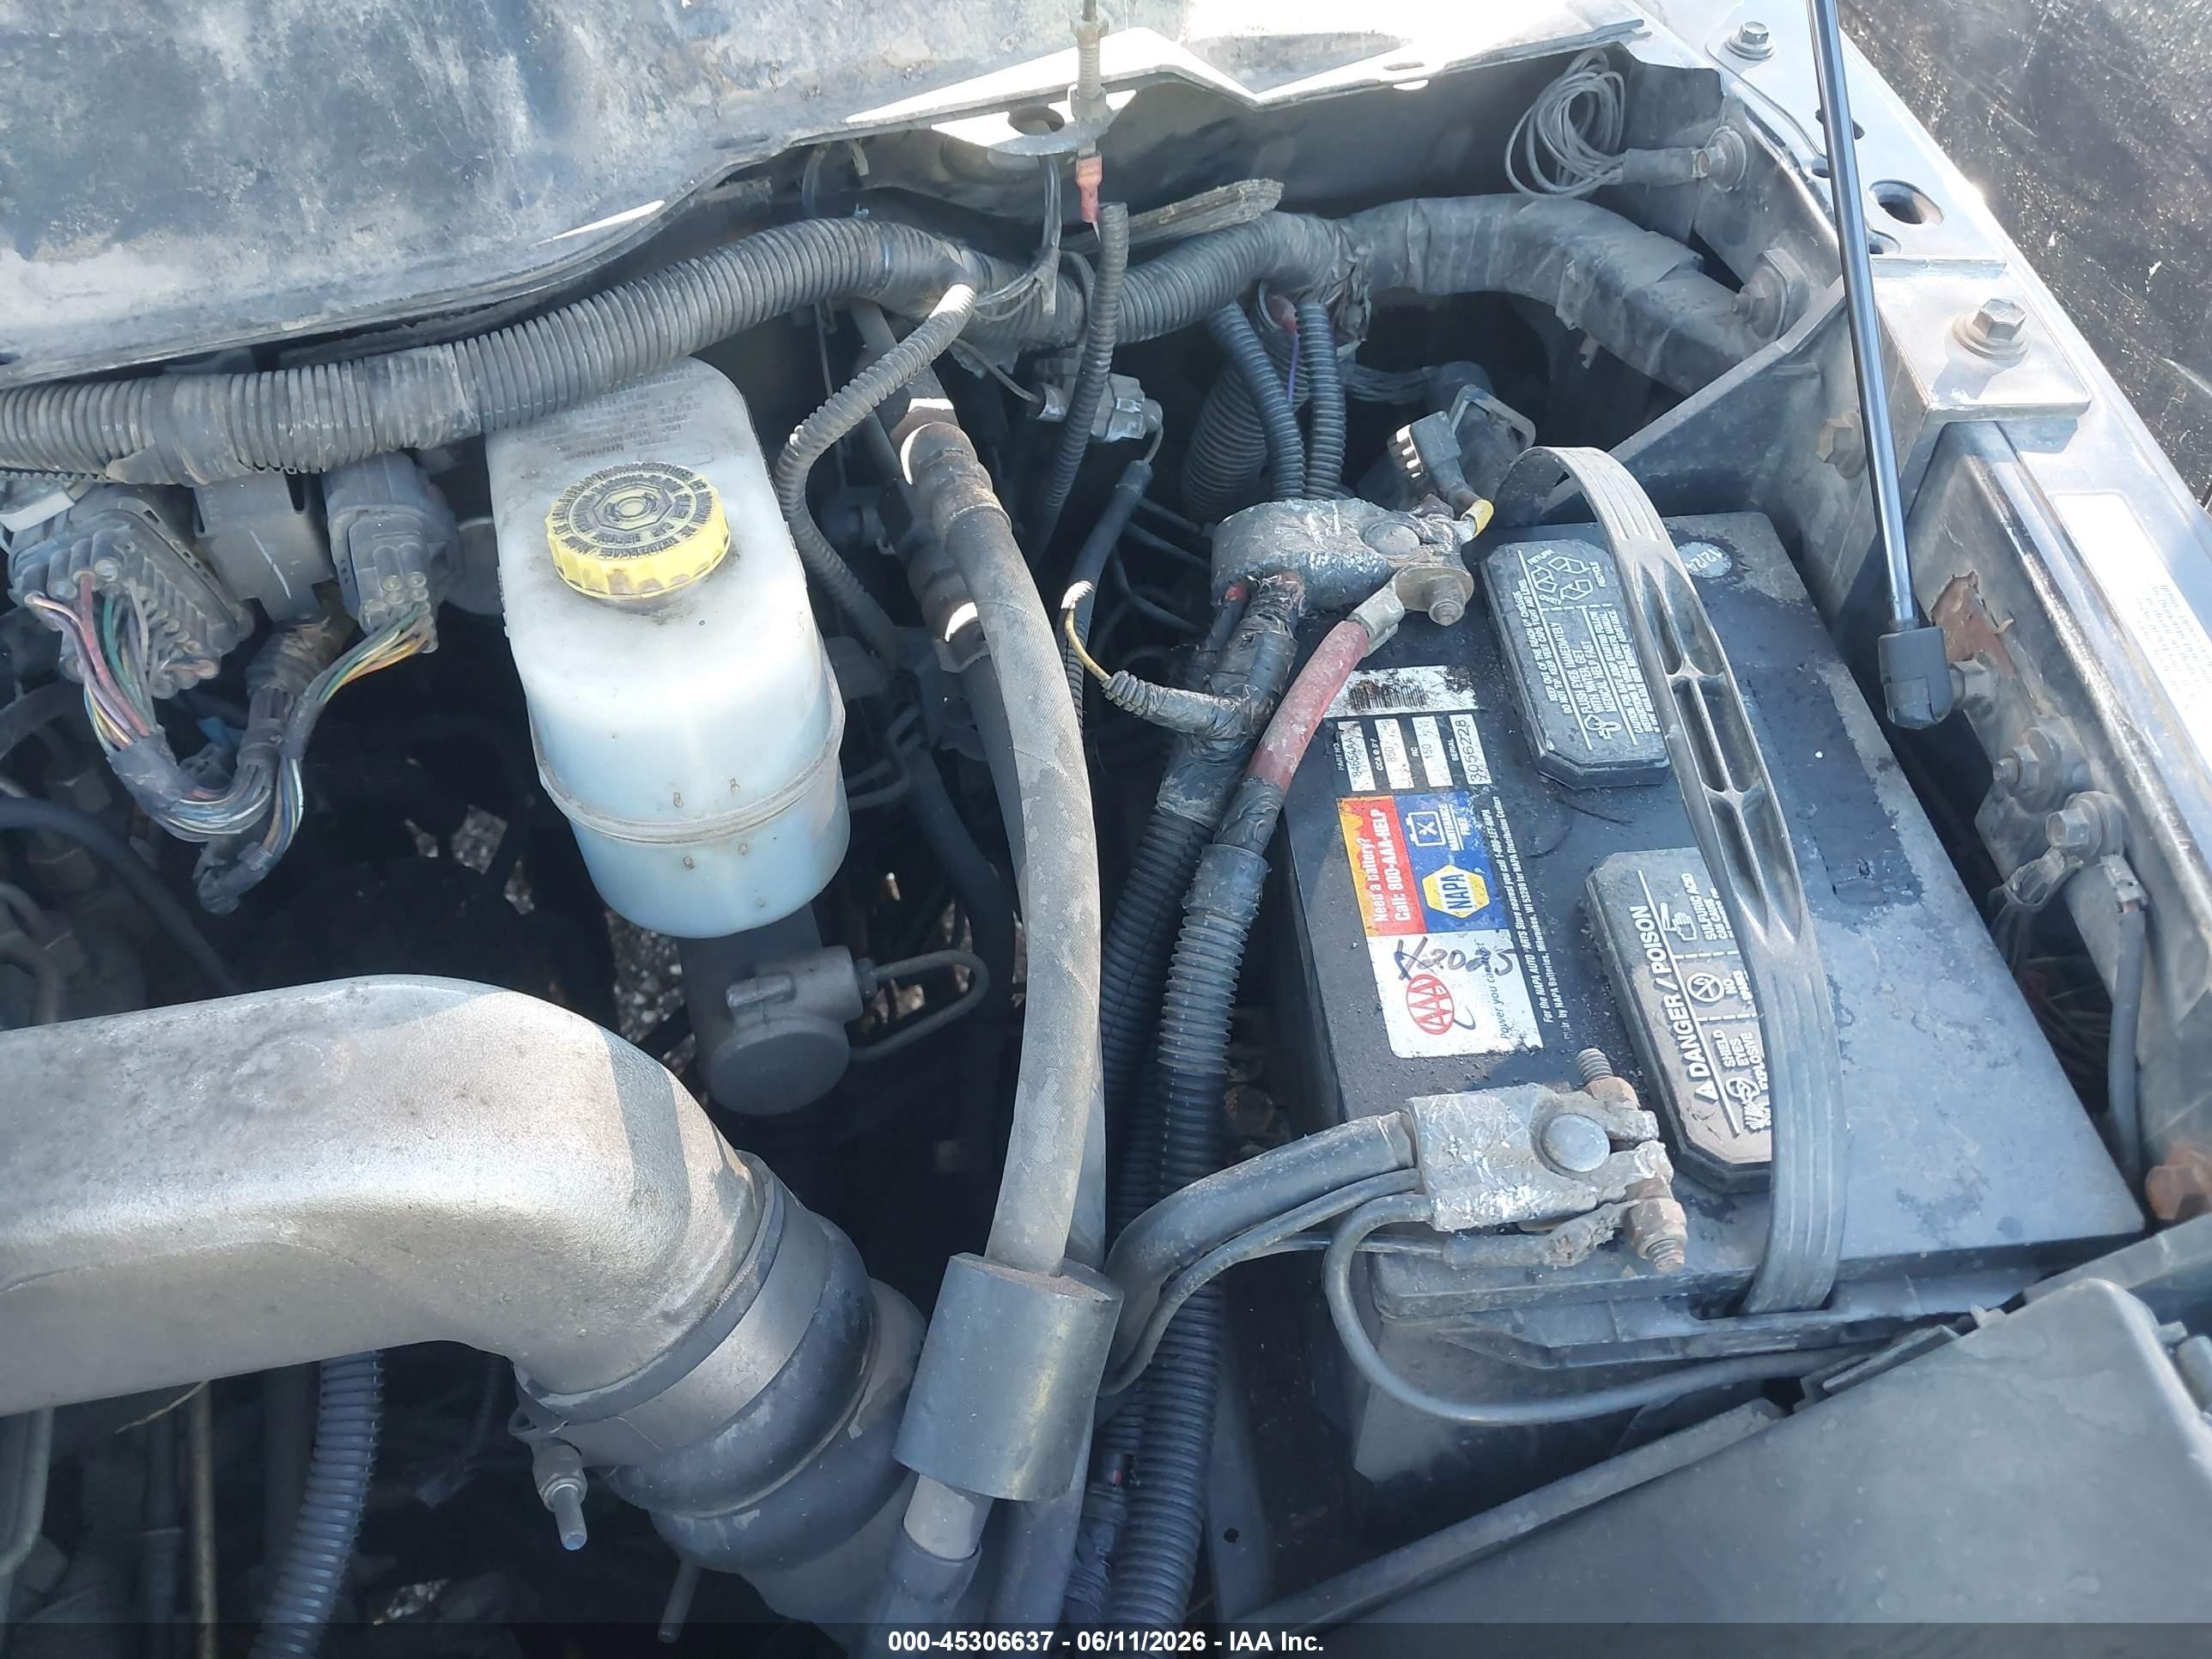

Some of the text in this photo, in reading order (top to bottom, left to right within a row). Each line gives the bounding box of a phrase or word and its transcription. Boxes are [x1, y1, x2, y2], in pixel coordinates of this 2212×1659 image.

[1685, 549, 1723, 572] 12/24
[1523, 596, 1534, 608] AND
[1534, 626, 1547, 642] CAPS
[1540, 643, 1553, 659] VENT
[1572, 649, 1585, 664] GET
[1536, 661, 1547, 671] OF
[1546, 659, 1559, 675] KEEP
[1549, 621, 1592, 714] FLUSH EYES IMMEDIATELY
[1540, 672, 1552, 684] OUT
[1580, 640, 1617, 711] MEDICAL HELP FAST
[1544, 684, 1558, 701] KEEP
[1557, 690, 1569, 703] NOT
[1562, 704, 1572, 713] DO
[1588, 693, 1605, 712] WITH
[1384, 746, 1396, 762] 850
[1410, 746, 1419, 756] RC
[1421, 743, 1434, 758] 150
[1447, 738, 1459, 761] SERIAL
[1455, 720, 1482, 781] 3056228
[1335, 753, 1345, 770] PART
[1374, 755, 1384, 770] CCA
[1490, 796, 1505, 817] Centers
[1437, 803, 1460, 850] MAINTENANCE
[1455, 817, 1471, 835] FREE
[1480, 809, 1504, 858] 1-800-LET-NAPA
[1497, 818, 1516, 853] Distribution
[1370, 808, 1412, 921] Call: 800-AAA-HELP
[1495, 860, 1507, 871] call
[1508, 854, 1522, 871] NAPA
[1356, 837, 1389, 921] Need a battery?
[1500, 872, 1513, 885] you
[1513, 872, 1525, 881] for
[1438, 873, 1473, 909] NAPA
[1504, 886, 1520, 910] nearest
[1516, 882, 1532, 902] 53209
[1523, 903, 1534, 913] WI
[1679, 872, 1718, 942] SULFURIC ACID
[1703, 897, 1721, 921] CAUSE
[1510, 911, 1525, 929] Store
[1714, 923, 1729, 939] CAN
[1523, 954, 1539, 973] AUTO
[1530, 975, 1546, 995] NAPA
[1628, 904, 1711, 1077] DANGER / POISON
[1721, 978, 1739, 994] NO
[1401, 975, 1459, 1032] AAA
[1488, 985, 1504, 1005] you
[1537, 996, 1549, 1008] the
[1550, 987, 1565, 1007] NAPA
[1540, 1008, 1554, 1023] For
[1557, 1008, 1569, 1017] by
[1492, 1006, 1510, 1039] Power
[1711, 1029, 1737, 1066] SHIELD
[1727, 1038, 1751, 1065] EYES
[1741, 1030, 1771, 1091] EXPLOSIVE
